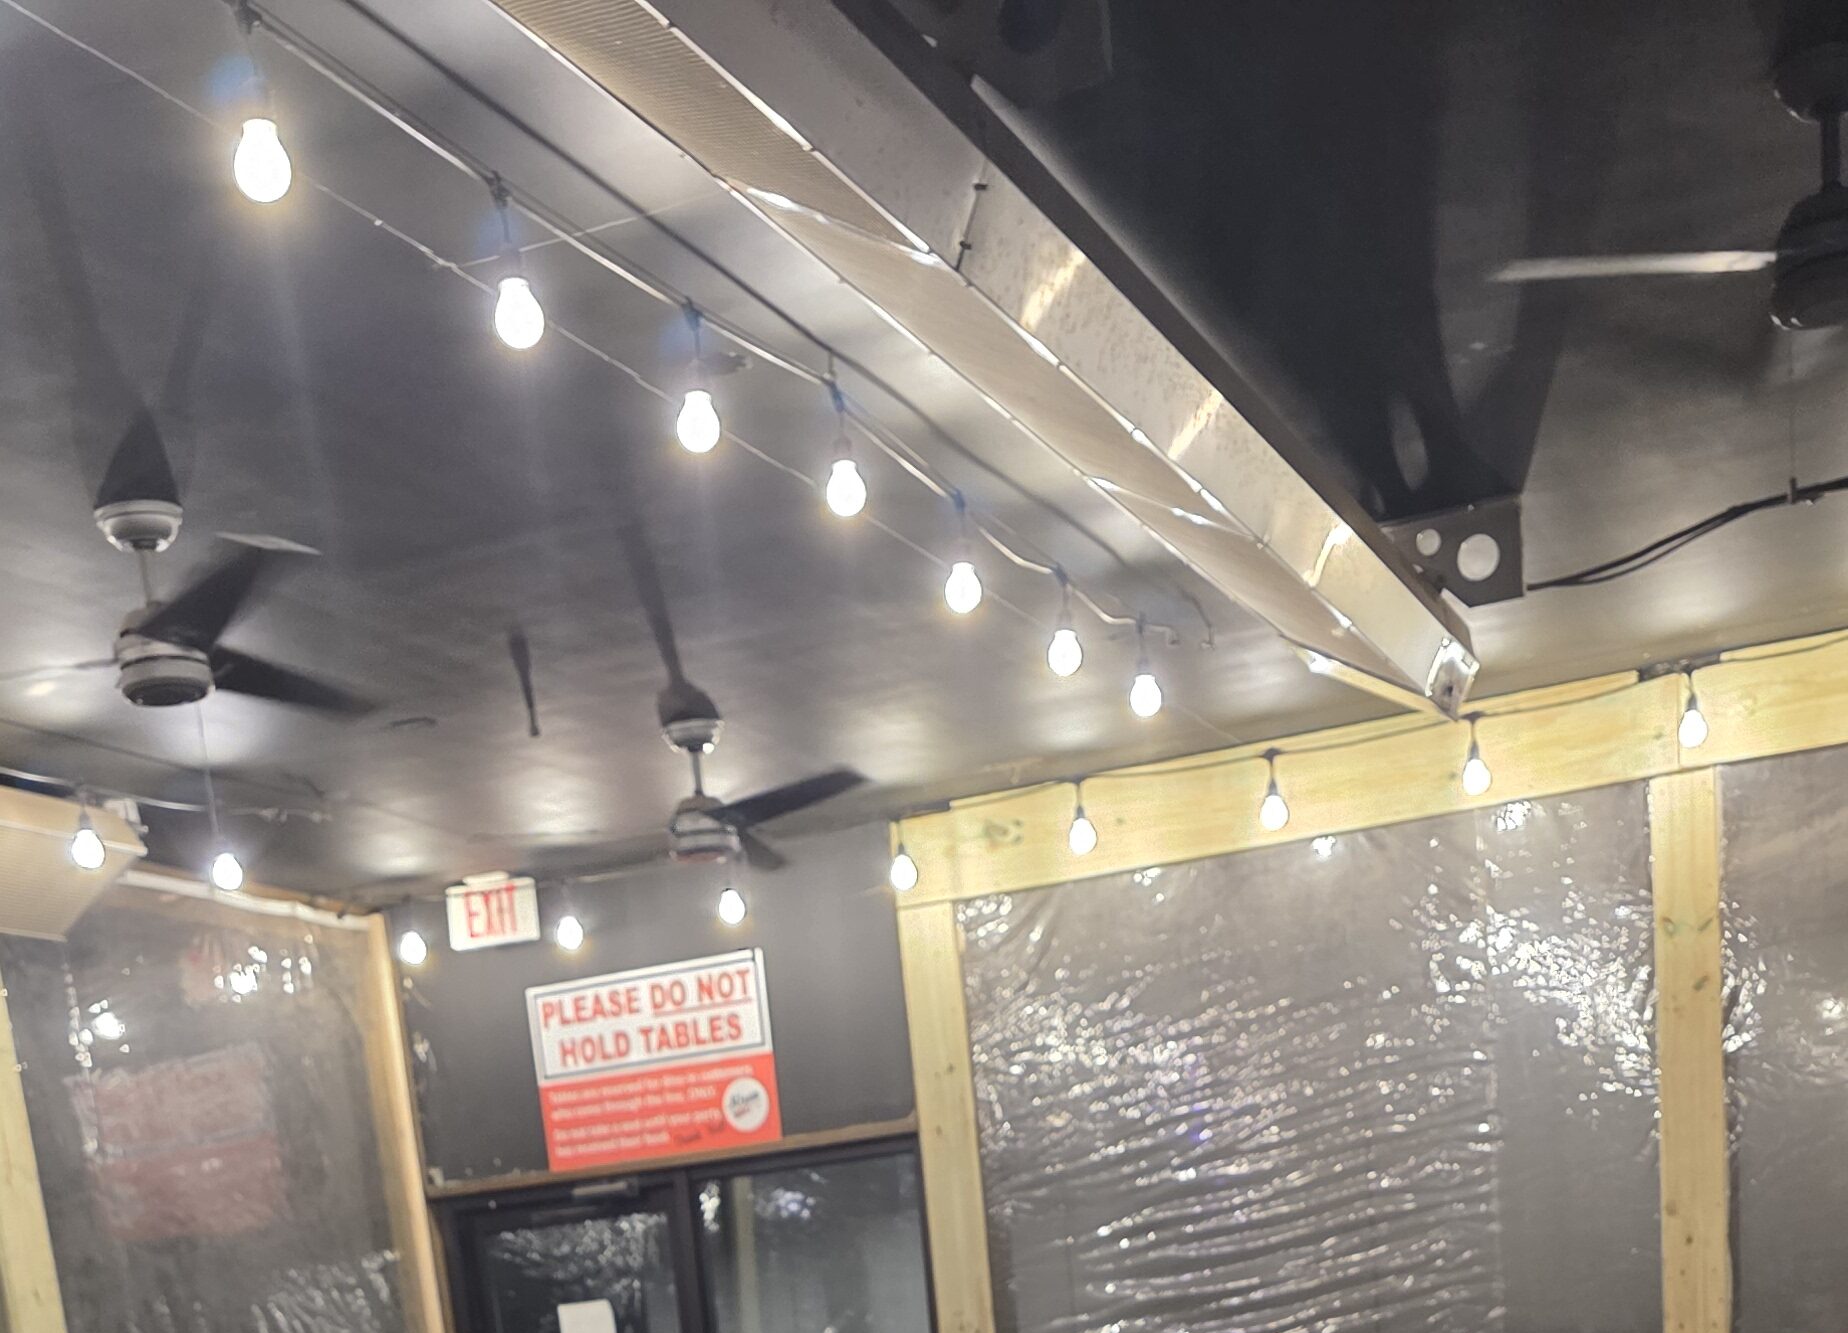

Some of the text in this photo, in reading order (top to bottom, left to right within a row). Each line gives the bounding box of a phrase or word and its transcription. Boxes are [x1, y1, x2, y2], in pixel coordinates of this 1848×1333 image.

[464, 883, 519, 938] EXIT
[542, 969, 752, 1028] PLEASE DO NOT
[560, 1013, 743, 1067] HOLD TABLES
